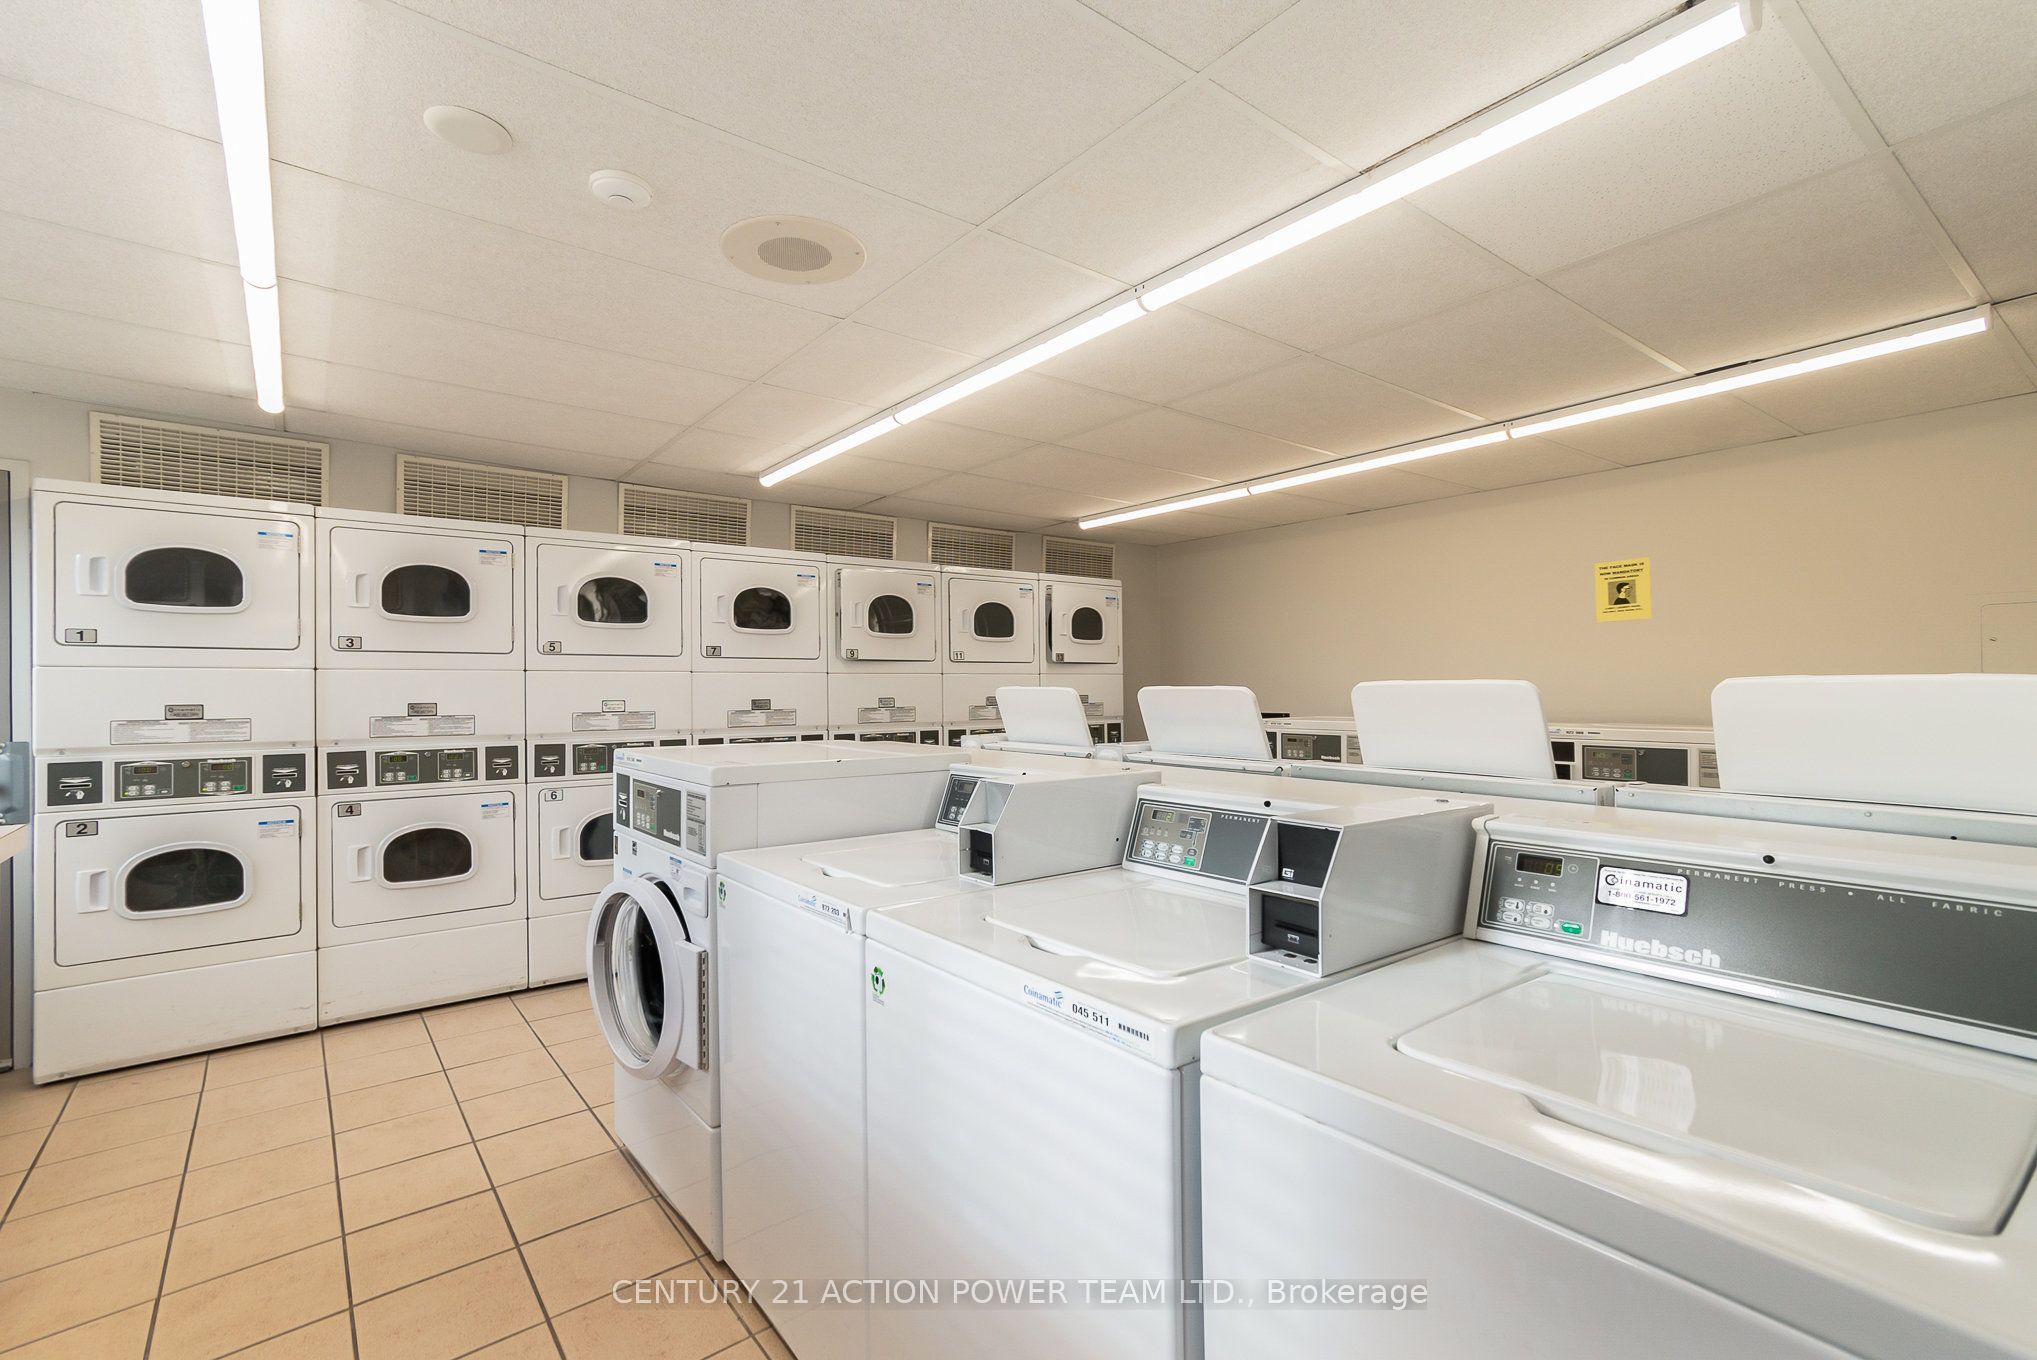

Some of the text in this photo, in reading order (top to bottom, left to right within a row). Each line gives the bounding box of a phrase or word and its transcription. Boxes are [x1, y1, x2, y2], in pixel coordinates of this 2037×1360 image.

[76, 630, 83, 641] 1
[345, 637, 354, 648] 3
[549, 642, 556, 652] 5
[711, 647, 717, 655] 7
[850, 650, 855, 658] 9
[550, 791, 558, 800] 6
[345, 805, 354, 815] 4
[1221, 814, 1261, 824] PERMANENT
[76, 823, 88, 835] 2
[1677, 868, 1759, 884] PERMANENT
[1779, 881, 1827, 894] PRESS
[1877, 894, 1906, 904] ALL
[1932, 901, 2003, 917] FABRIC
[1634, 893, 1676, 907] 561-1972
[1600, 930, 1721, 968] Huebsch
[1023, 984, 1063, 1008] Coinamatic
[1072, 1003, 1109, 1027] 045 511
